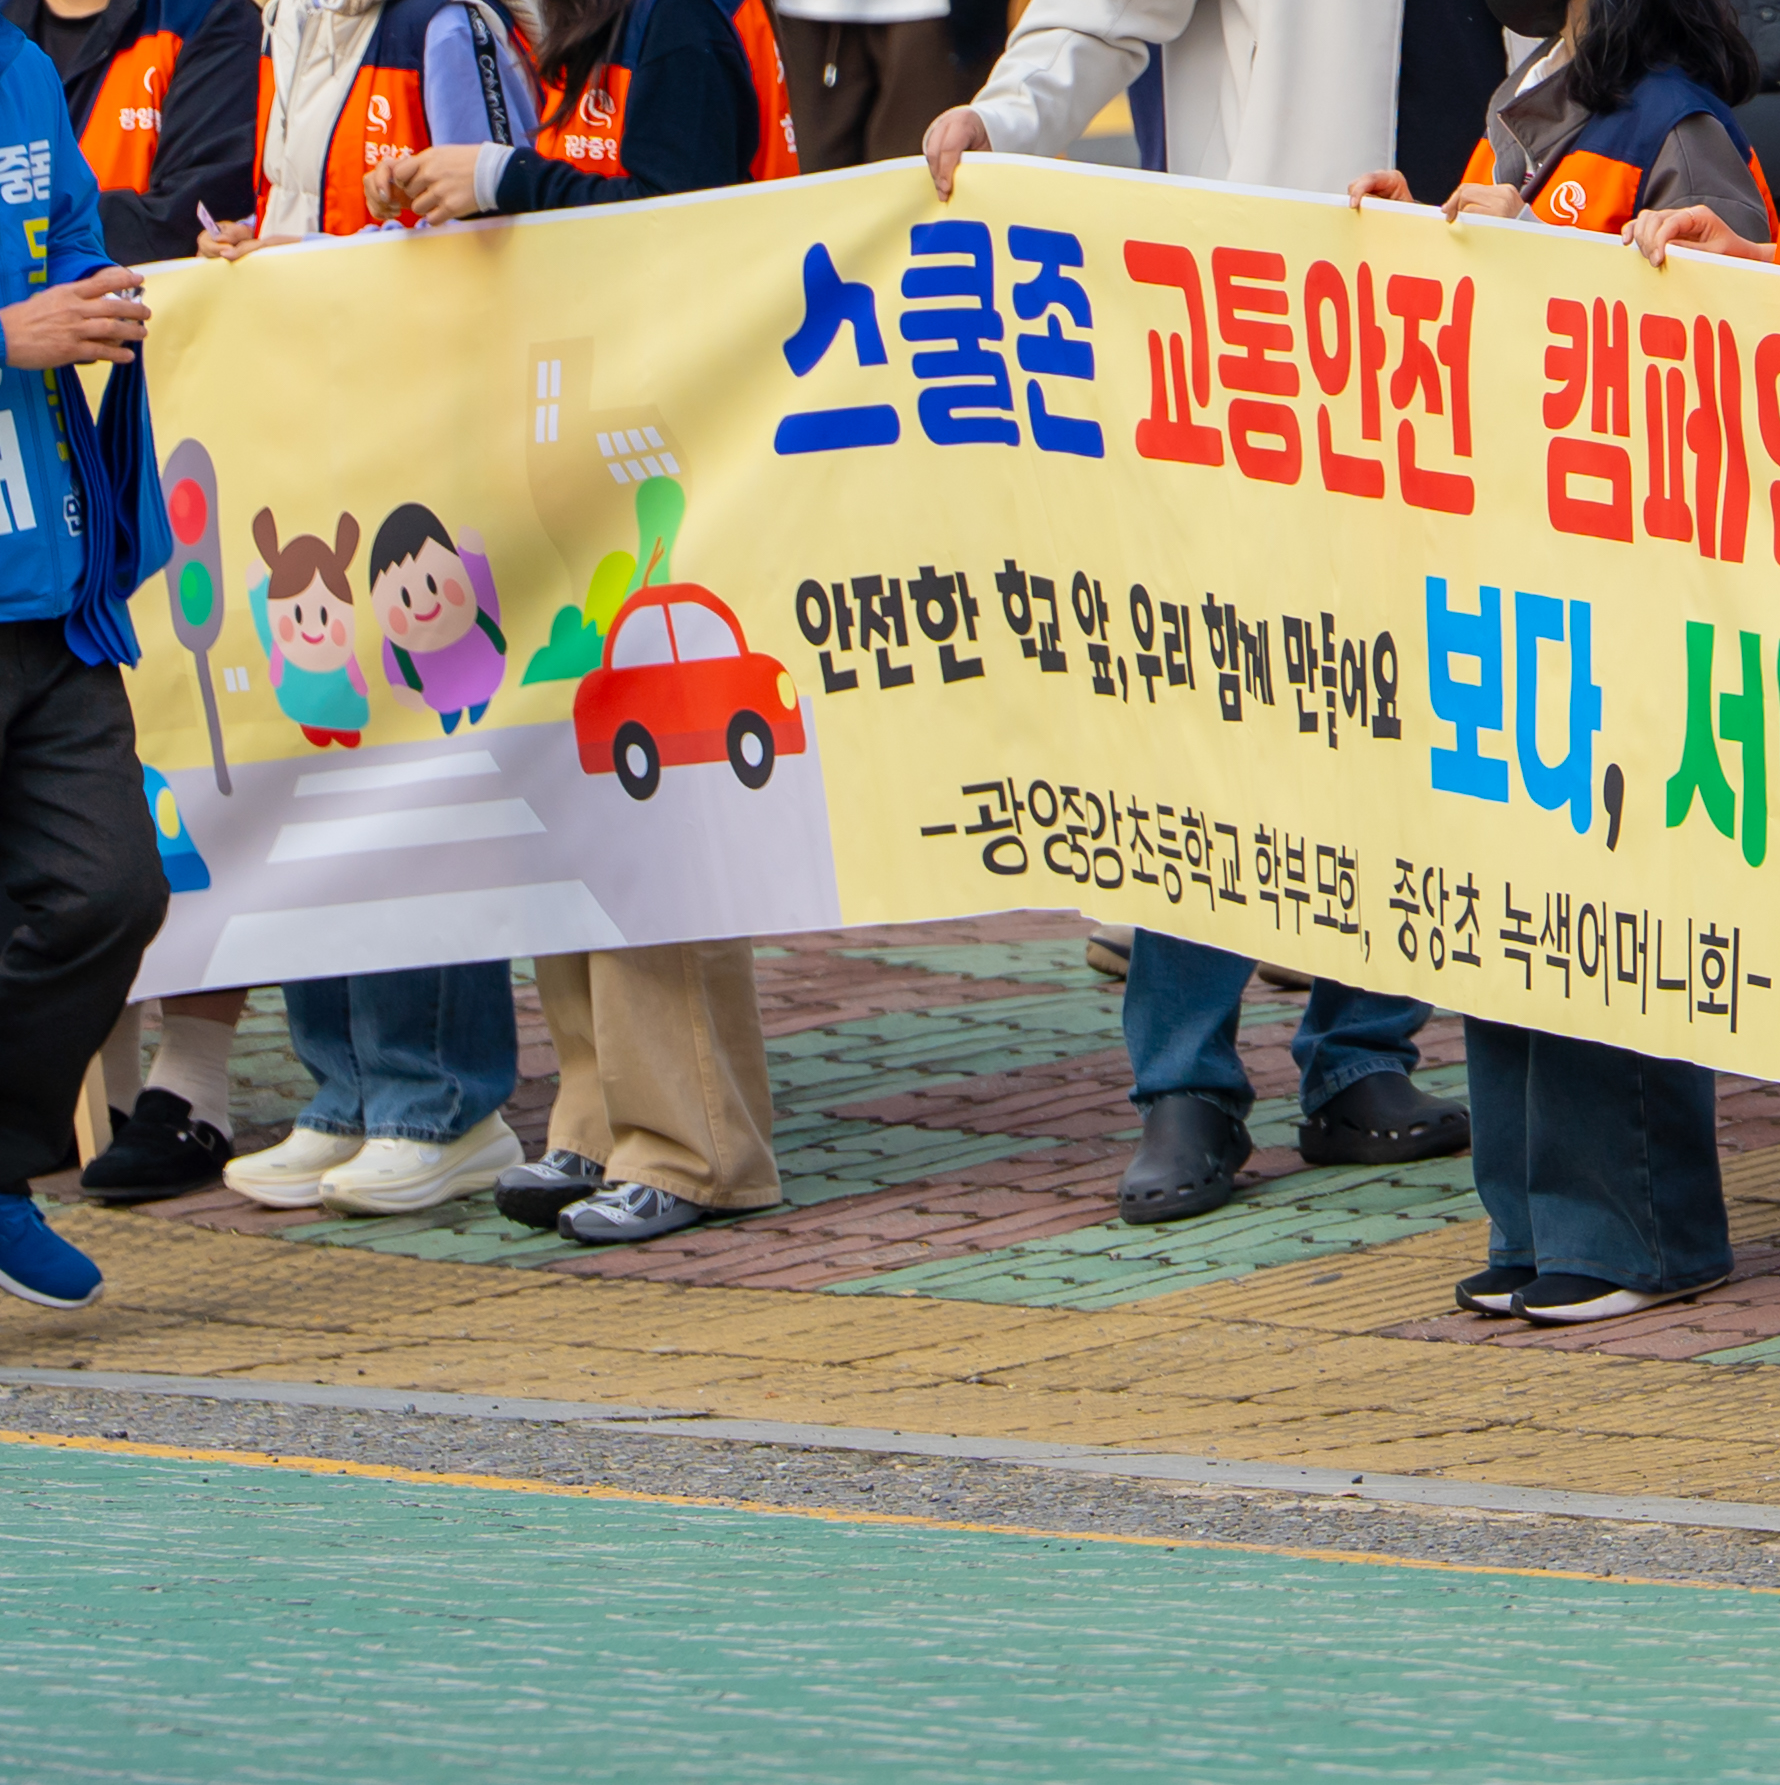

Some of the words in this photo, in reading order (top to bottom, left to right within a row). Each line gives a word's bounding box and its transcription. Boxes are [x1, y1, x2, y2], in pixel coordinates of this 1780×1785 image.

[119, 106, 162, 132] 광양
[773, 217, 1106, 459] 스쿨존
[1122, 238, 1477, 517] 교통안전
[795, 564, 987, 695] 안전한
[994, 557, 1069, 674] 학교
[1201, 591, 1276, 723] 함께
[1281, 610, 1403, 751] 만들어요
[1426, 575, 1626, 853] 보다,
[1254, 822, 1374, 965] 학부모회,
[1389, 856, 1482, 972] 중앙초
[1499, 880, 1773, 1035] 녹색어머니회-
